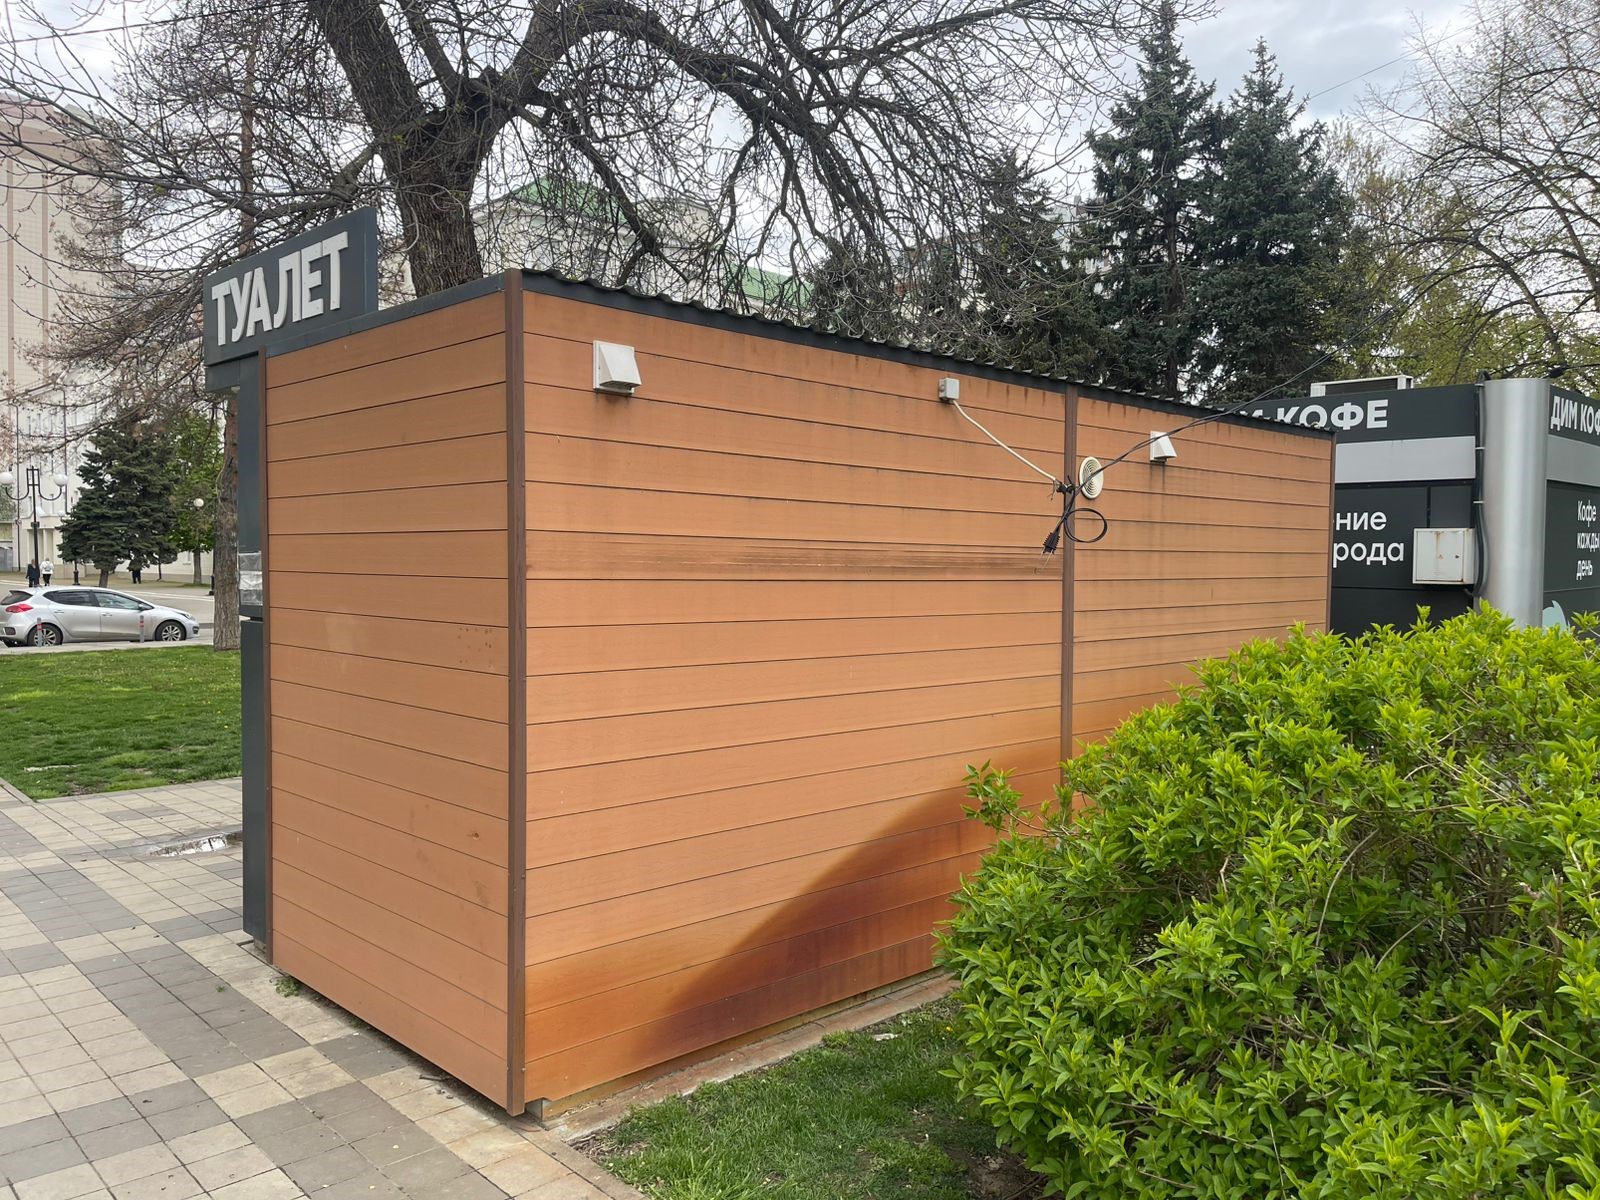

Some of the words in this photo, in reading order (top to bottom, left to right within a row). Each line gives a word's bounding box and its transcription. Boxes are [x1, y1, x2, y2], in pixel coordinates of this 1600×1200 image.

[211, 231, 348, 346] ТУАЛЕТ
[1550, 395, 1578, 431] ДИМ
[1333, 511, 1387, 531] ние
[1577, 499, 1597, 528] Кофе
[1332, 542, 1404, 568] рода
[1575, 559, 1593, 581] день
